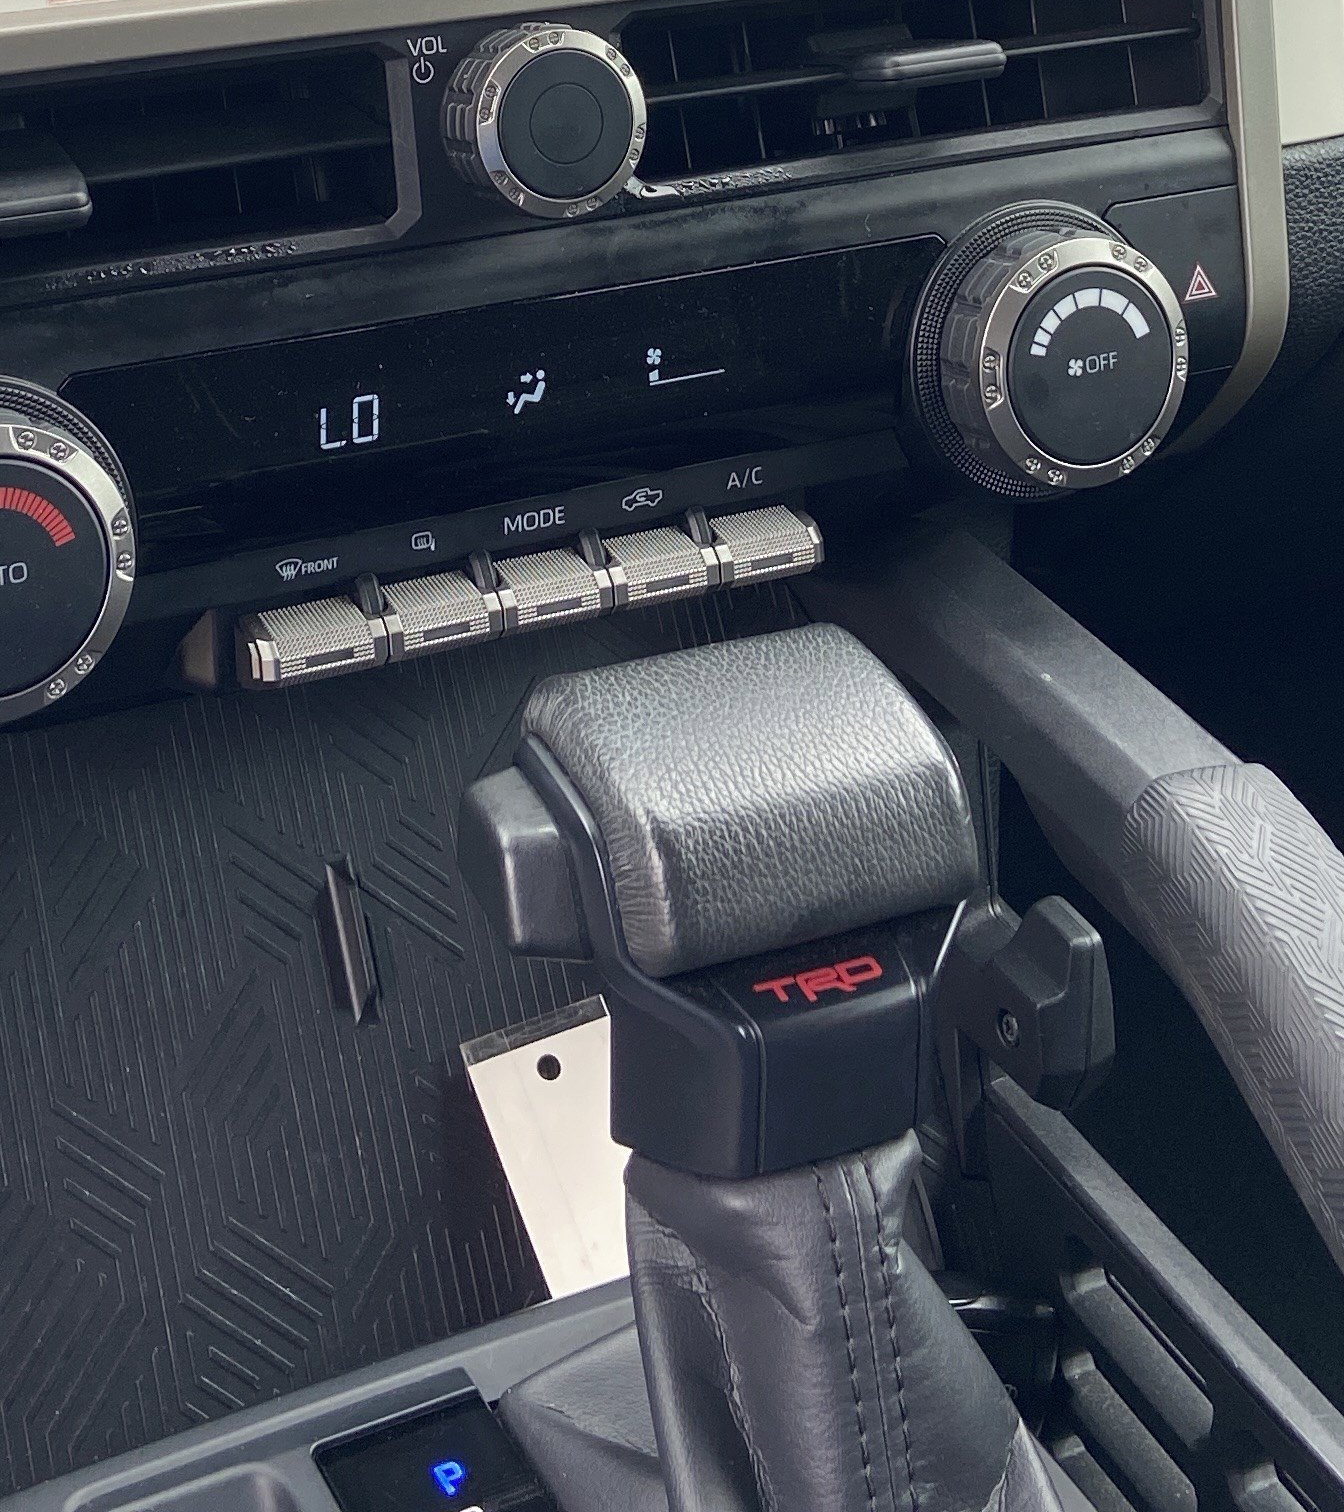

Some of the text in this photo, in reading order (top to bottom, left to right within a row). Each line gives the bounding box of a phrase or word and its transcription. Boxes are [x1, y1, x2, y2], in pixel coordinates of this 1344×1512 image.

[406, 36, 448, 56] VOL
[1085, 352, 1119, 374] OFF
[726, 465, 764, 490] A/C
[503, 506, 566, 536] MODE
[301, 556, 339, 577] FRONT
[752, 955, 883, 1003] TRD
[433, 1460, 464, 1496] P
